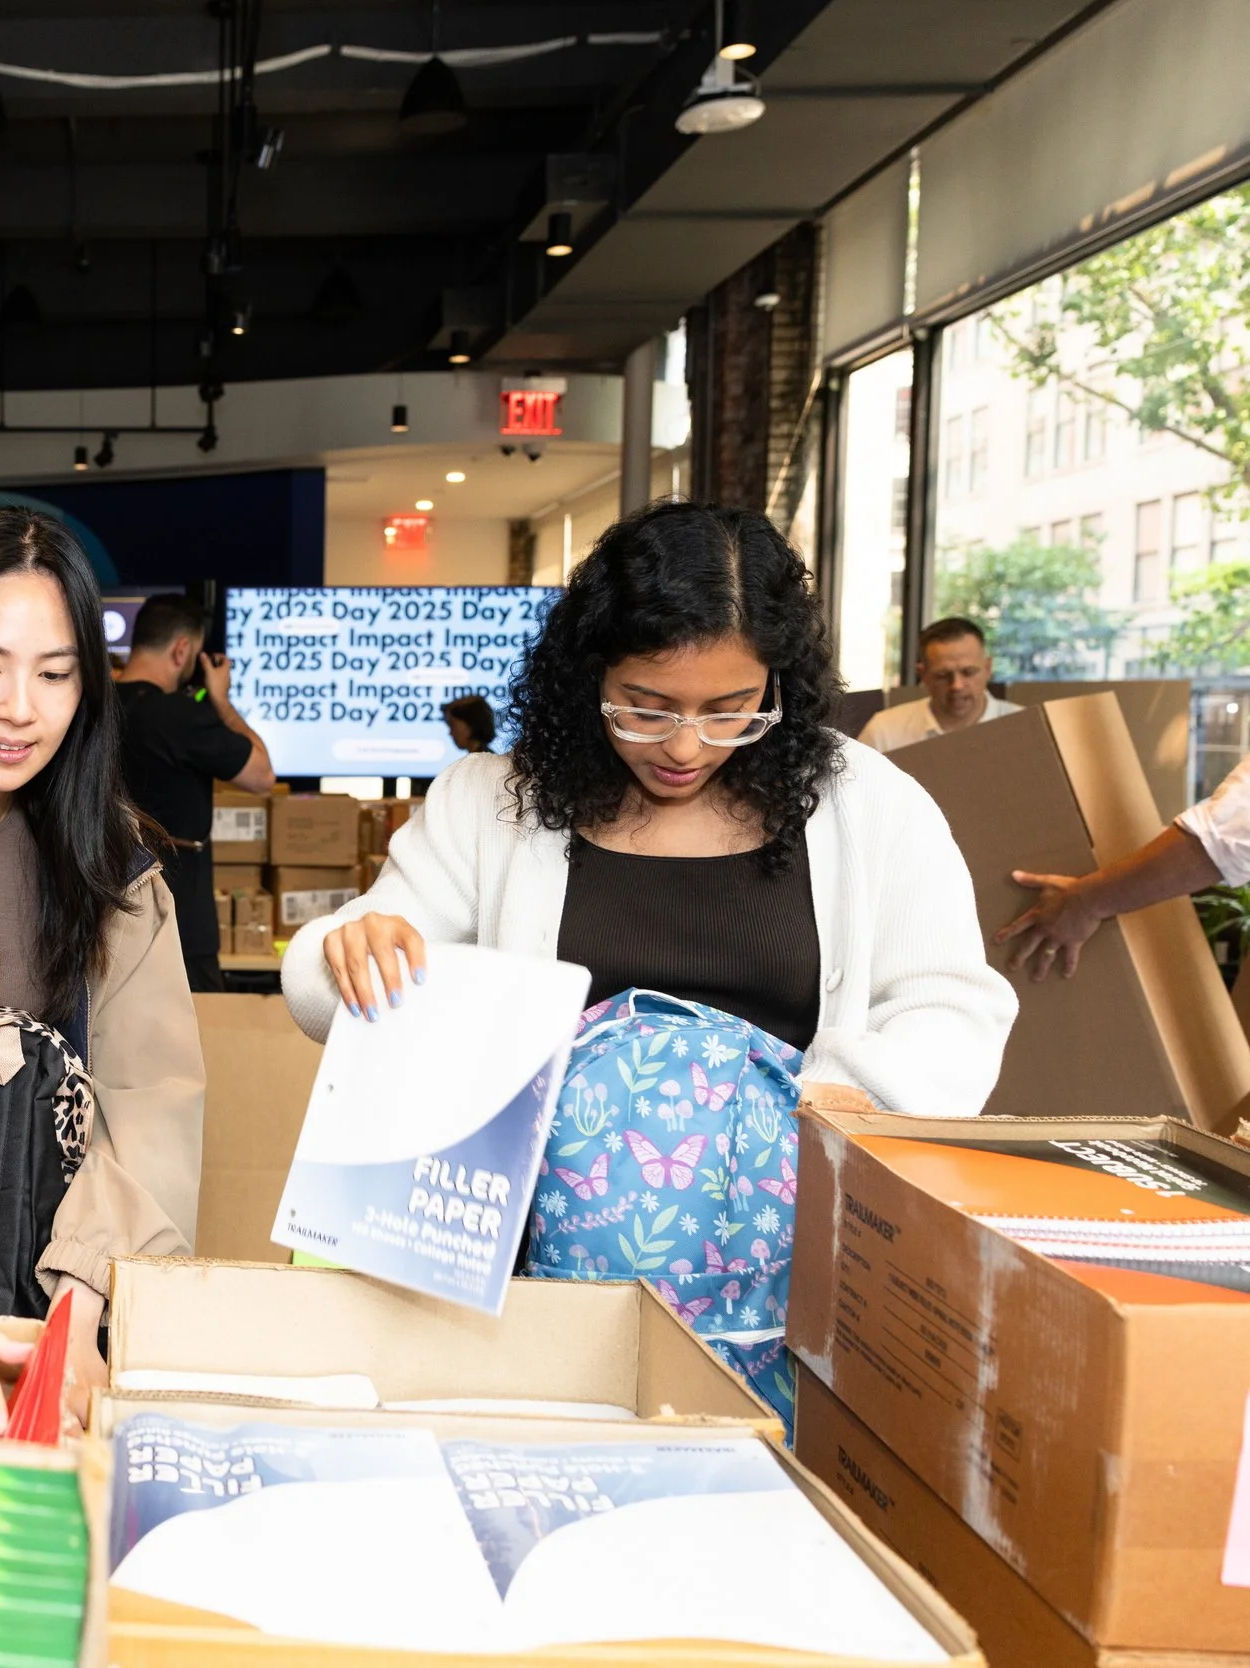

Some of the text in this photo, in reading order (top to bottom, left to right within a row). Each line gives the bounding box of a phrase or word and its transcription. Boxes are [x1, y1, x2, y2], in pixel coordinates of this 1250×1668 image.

[509, 391, 558, 429] EXIT
[227, 607, 252, 626] ay
[260, 601, 323, 620] 2025
[332, 601, 380, 626] Day
[388, 601, 452, 620] 2025
[462, 601, 511, 626] Day
[256, 628, 338, 652] Impact
[350, 628, 433, 653] Impact
[260, 651, 322, 670] 2025
[331, 651, 379, 676] Day
[387, 651, 451, 670] 2025
[461, 651, 510, 676] Day
[255, 678, 337, 702] Impact
[350, 679, 432, 702] Impact
[259, 702, 321, 721] 2025
[330, 702, 379, 727] Day
[1048, 1140, 1171, 1190] SUBJECT
[412, 1155, 511, 1207] FILLER
[408, 1186, 503, 1240] PAPER
[286, 1222, 339, 1248] TRAILMAKER
[421, 1221, 496, 1262] Punched
[128, 1445, 255, 1478] PAPER
[128, 1464, 263, 1497] FILLER
[460, 1471, 599, 1493] PAPER
[468, 1489, 615, 1512] FILLER
